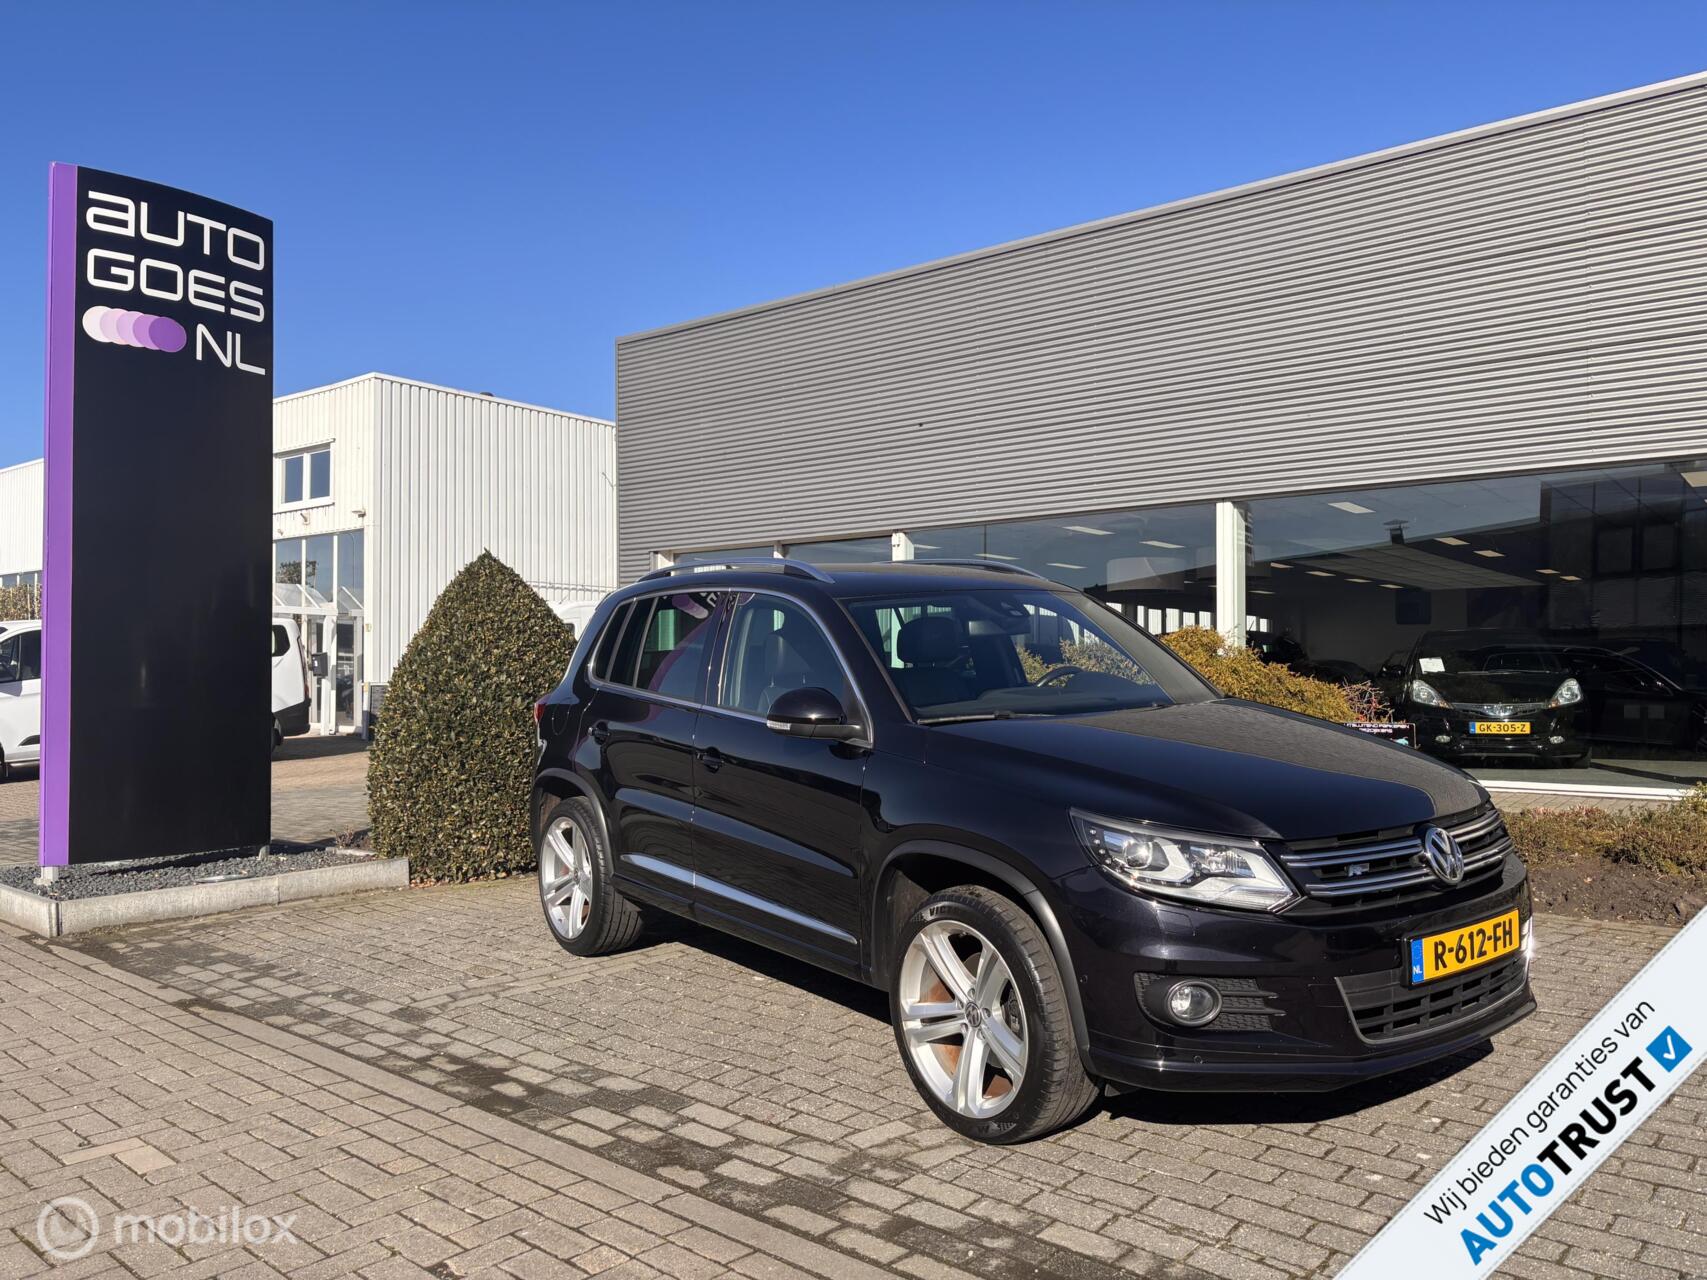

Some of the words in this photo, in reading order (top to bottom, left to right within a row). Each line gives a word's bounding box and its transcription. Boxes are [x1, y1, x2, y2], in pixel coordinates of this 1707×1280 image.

[86, 248, 264, 322] GOES
[196, 323, 265, 375] NL
[1479, 724, 1526, 732] GK-305-Z
[1434, 918, 1512, 971] R-612-FH
